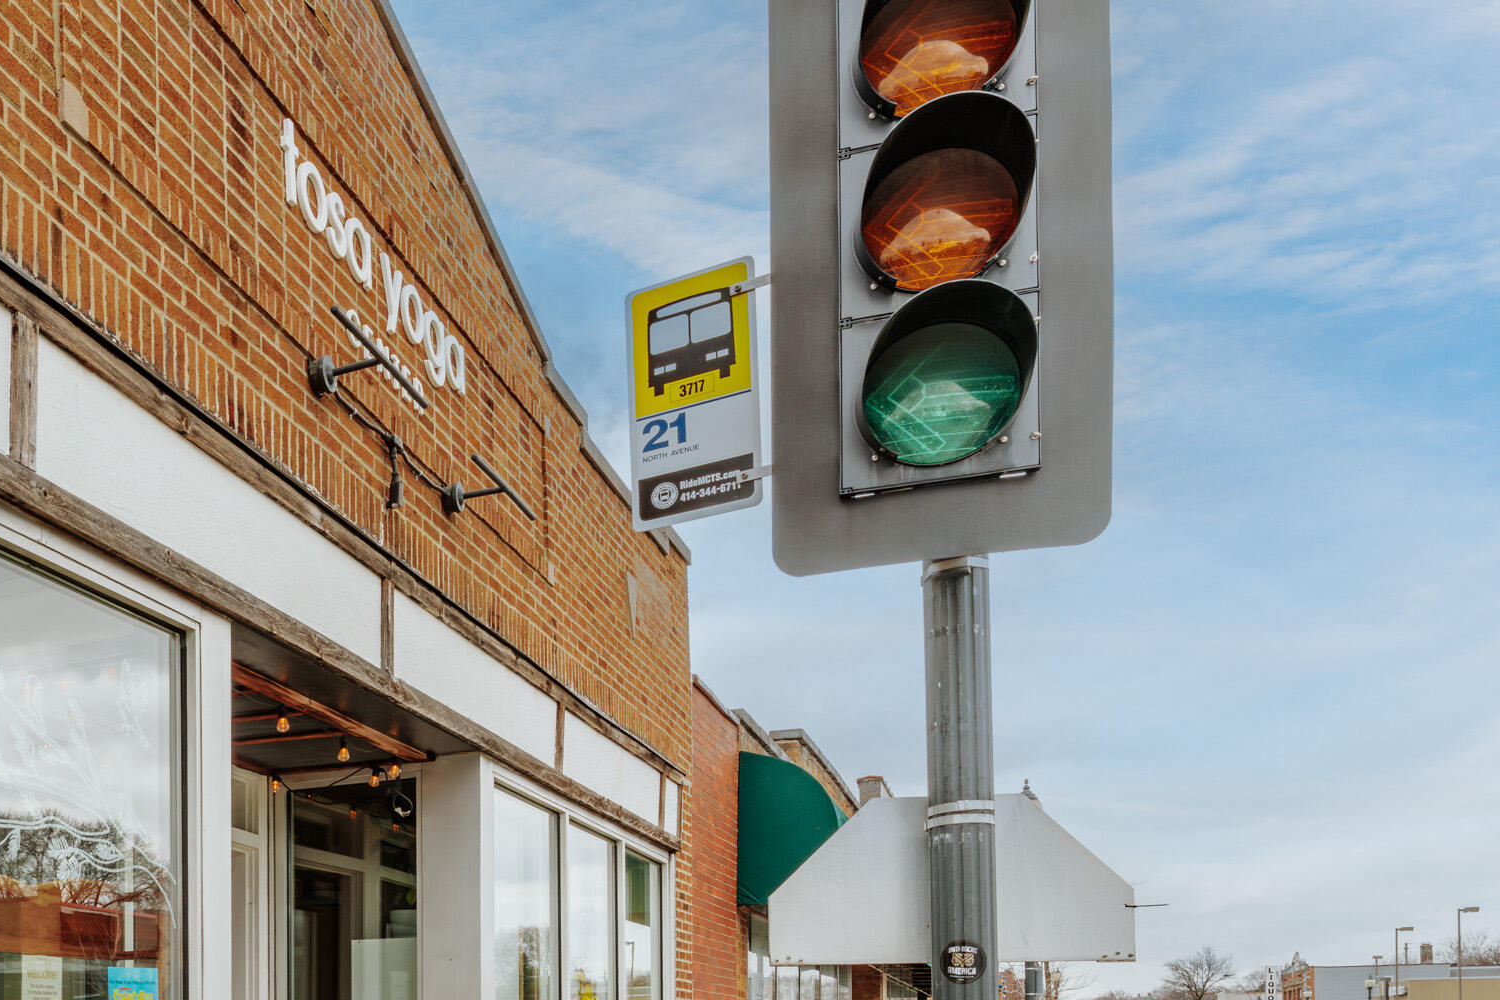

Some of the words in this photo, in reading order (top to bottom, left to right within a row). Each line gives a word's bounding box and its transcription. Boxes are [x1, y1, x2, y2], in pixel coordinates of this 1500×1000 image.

[280, 118, 373, 293] tosa
[379, 252, 466, 395] yoga
[679, 379, 705, 399] 3717
[642, 412, 687, 454] 21
[642, 452, 668, 464] NORTH
[670, 444, 700, 457] AVENUE
